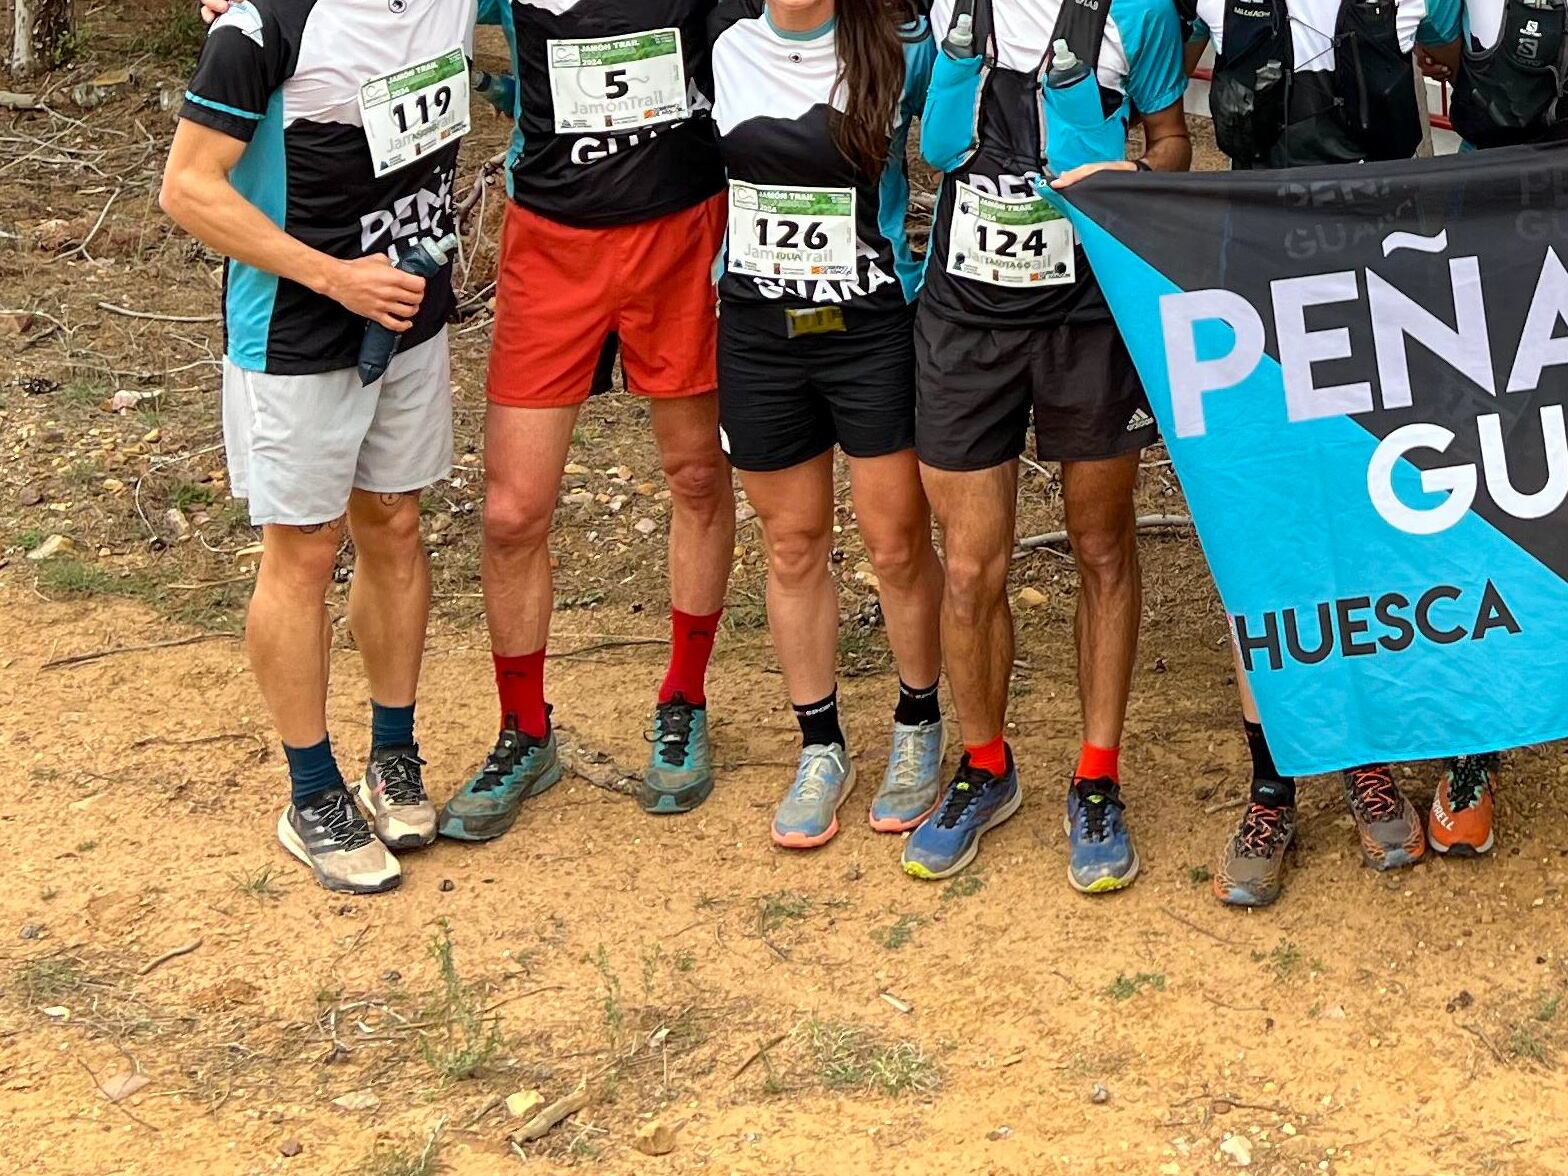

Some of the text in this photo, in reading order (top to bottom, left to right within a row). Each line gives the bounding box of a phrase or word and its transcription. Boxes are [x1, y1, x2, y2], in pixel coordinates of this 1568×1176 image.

[604, 69, 629, 99] 5
[392, 85, 451, 133] 119
[756, 218, 828, 250] 126
[977, 224, 1048, 258] 124
[1238, 578, 1524, 671] HUESCA
